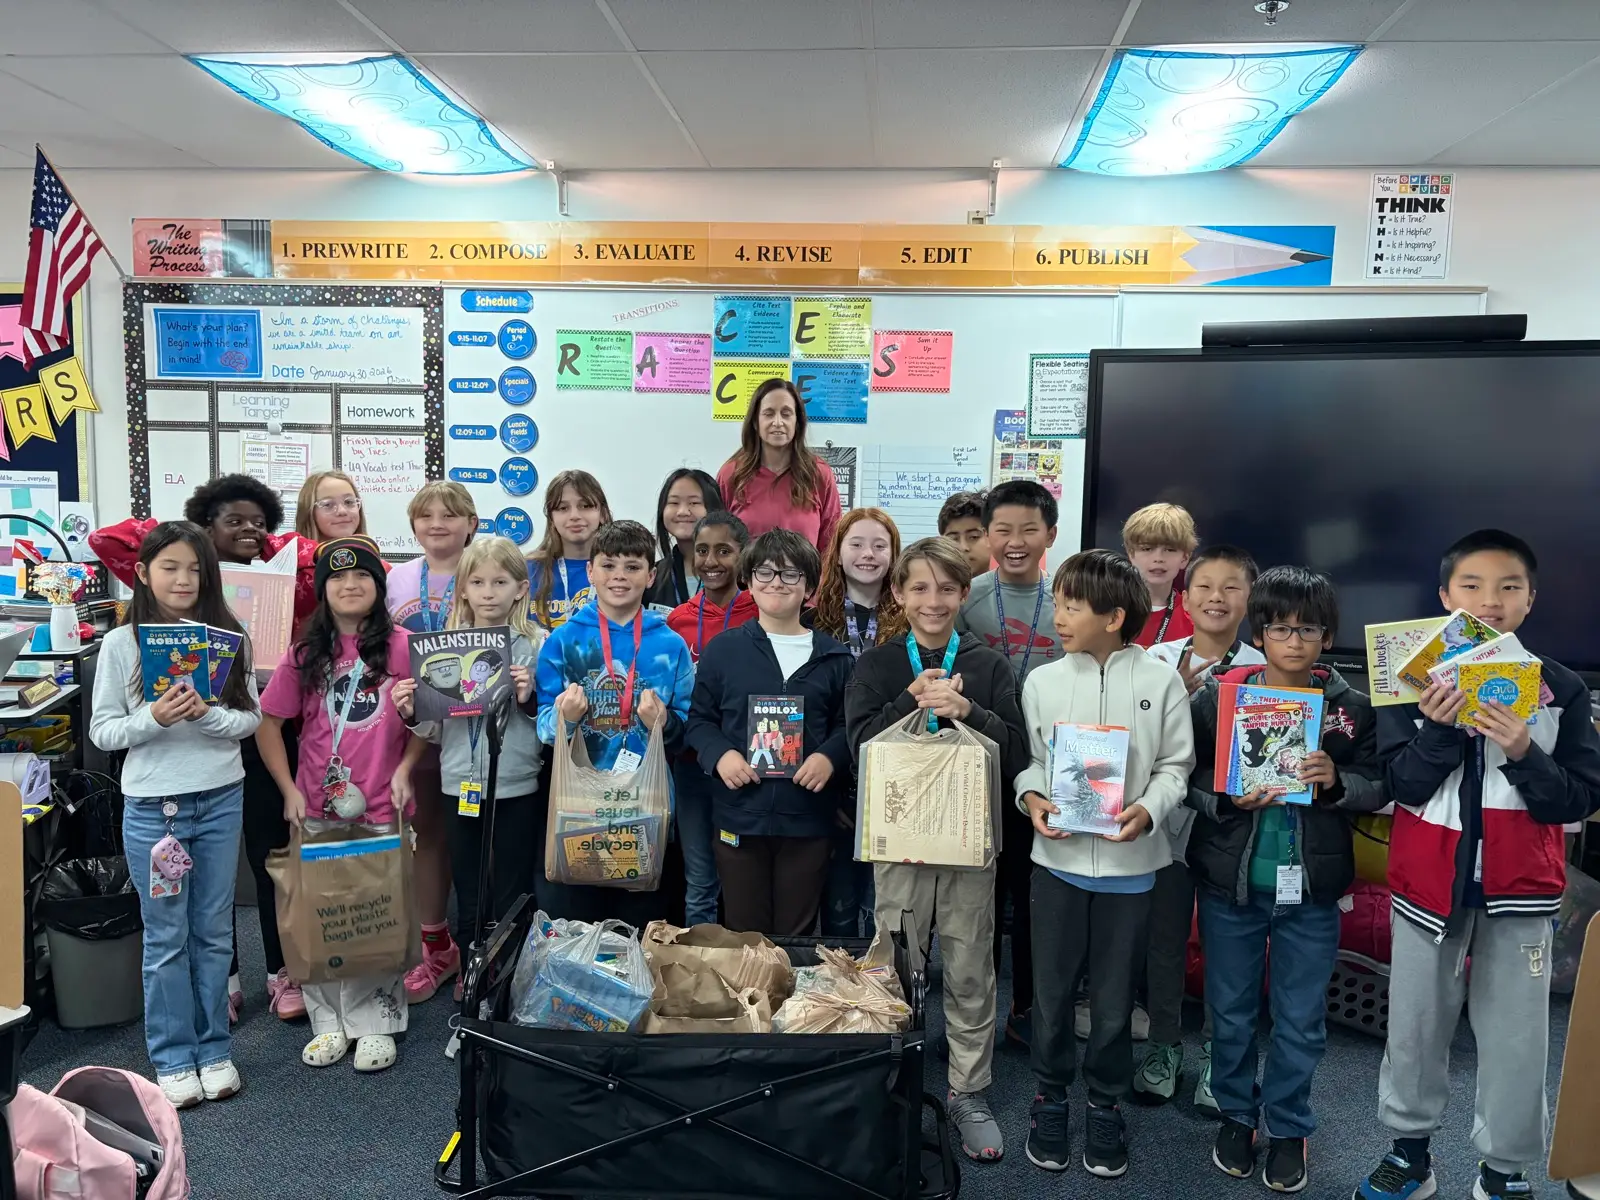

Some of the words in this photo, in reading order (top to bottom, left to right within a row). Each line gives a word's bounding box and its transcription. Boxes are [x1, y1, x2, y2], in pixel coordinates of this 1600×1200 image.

[1377, 176, 1398, 184] Before
[1375, 197, 1446, 213] THINK
[1378, 215, 1386, 224] T
[1407, 215, 1427, 223] True?
[163, 223, 192, 240] The
[1376, 227, 1386, 236] H
[1406, 227, 1432, 238] Helpful?
[147, 239, 207, 260] Writing
[1405, 240, 1436, 251] Inspiring?
[282, 243, 296, 259] 1.
[302, 243, 408, 259] PREWRITE
[429, 244, 444, 260] 2.
[450, 244, 548, 260] COMPOSE
[573, 244, 589, 260] 3.
[595, 244, 697, 261] EVALUATE
[734, 246, 750, 262] 4.
[756, 245, 833, 262] REVISE
[900, 248, 917, 264] 5.
[922, 247, 972, 264] EDIT
[1036, 248, 1052, 265] 6.
[1059, 248, 1150, 265] PUBLISH
[1374, 253, 1384, 261] N
[1403, 253, 1441, 264] Necessary?
[149, 255, 207, 272] Process
[1373, 266, 1381, 274] K
[1403, 266, 1422, 275] Kind?
[475, 295, 518, 307] Schedule
[612, 299, 679, 323] TRANSITIONS
[753, 309, 780, 317] Evidence
[300, 316, 308, 324] a
[715, 309, 738, 343] C
[166, 321, 198, 331] What's
[201, 325, 223, 333] your
[226, 322, 248, 334] plan?
[506, 326, 527, 334] Period
[795, 311, 821, 344] E
[167, 337, 190, 351] Begin
[193, 338, 212, 348] with
[215, 338, 230, 348] the
[233, 339, 248, 348] end
[923, 345, 932, 353] Up
[168, 355, 176, 363] in
[179, 354, 201, 364] mind!
[557, 343, 581, 376] R
[635, 345, 660, 379] A
[873, 343, 899, 378] S
[1035, 360, 1062, 368] Flexible
[1063, 360, 1089, 368] Seating
[272, 364, 305, 378] Date
[309, 365, 356, 382] January
[369, 366, 392, 376] 2026
[747, 369, 785, 378] Commentary
[1042, 368, 1082, 376] Expectations
[715, 372, 738, 404] C
[232, 394, 290, 408] Learning
[243, 406, 285, 420] Target
[347, 405, 415, 418] Homework
[455, 428, 487, 436] 12:09-1:01
[346, 436, 371, 445] Finish
[351, 447, 365, 458] by
[362, 462, 388, 472] Vocab
[391, 461, 404, 471] test
[508, 463, 529, 472] Period
[164, 473, 186, 485] ELA
[363, 475, 387, 483] Vocab
[388, 475, 410, 483] online
[458, 471, 488, 479] 1:06-1:58
[896, 471, 908, 481] We
[911, 471, 932, 482] start
[945, 475, 982, 486] paragraph
[878, 480, 887, 494] by
[928, 482, 945, 495] Every
[914, 491, 942, 499] touches
[504, 513, 525, 522] Period
[511, 521, 517, 529] 8
[375, 536, 392, 547] Fair
[1154, 617, 1170, 644] Southwest
[146, 636, 199, 646] ROBLOX
[412, 632, 506, 656] VALENSTEINS
[1373, 632, 1393, 669] bucket
[1333, 661, 1363, 669] Promethean
[1382, 669, 1388, 677] a
[1373, 679, 1393, 695] fill
[753, 706, 799, 714] ROBLOX
[1241, 721, 1269, 729] VAMPIRE
[1270, 719, 1297, 727] HUNTER
[1065, 740, 1117, 757] Matter
[316, 904, 346, 919] We'll
[349, 893, 393, 913] recycle
[321, 919, 347, 932] your
[350, 907, 389, 926] plastic
[323, 928, 355, 943] bags
[356, 923, 372, 936] for
